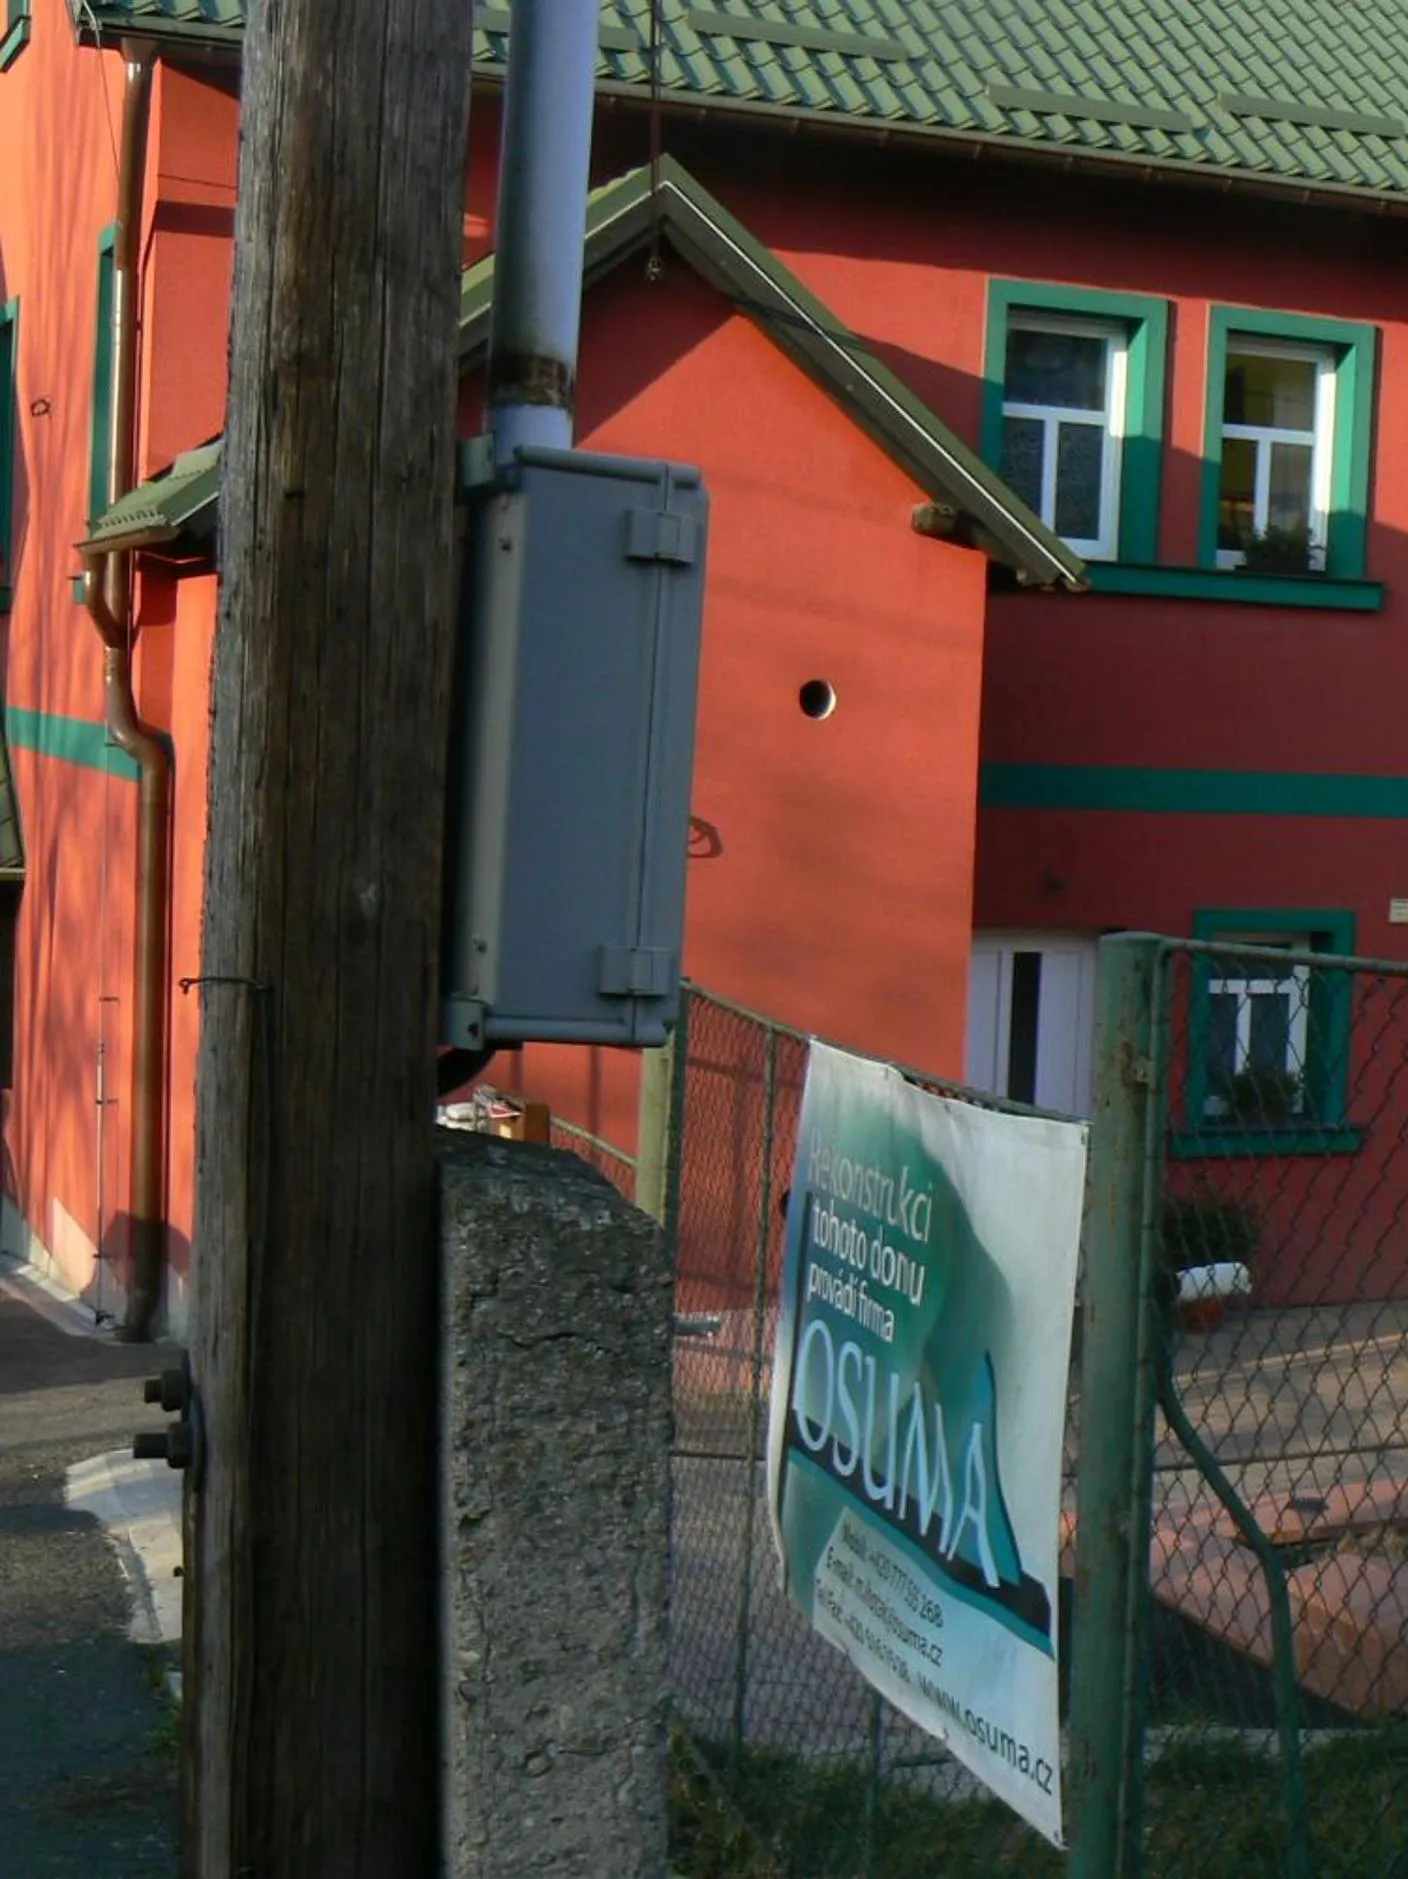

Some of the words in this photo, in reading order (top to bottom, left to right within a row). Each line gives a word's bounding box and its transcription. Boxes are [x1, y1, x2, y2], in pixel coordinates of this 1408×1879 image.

[808, 1127, 933, 1243] Rekonstrukci
[812, 1198, 867, 1271] tohoto
[858, 1279, 895, 1343] firma
[792, 1319, 999, 1588] OSUMA
[917, 1670, 1053, 1797] www.osuma.cz
